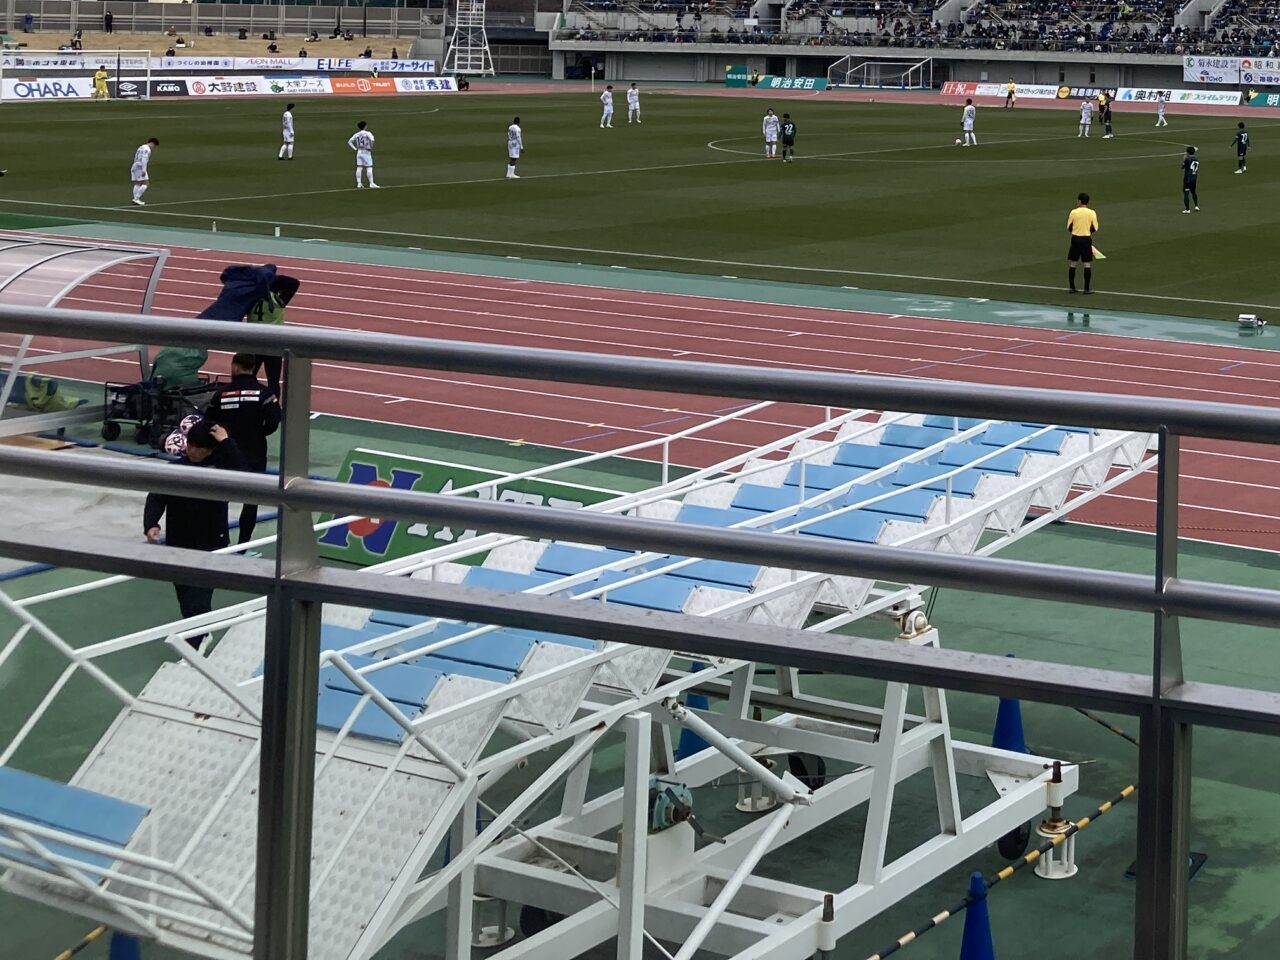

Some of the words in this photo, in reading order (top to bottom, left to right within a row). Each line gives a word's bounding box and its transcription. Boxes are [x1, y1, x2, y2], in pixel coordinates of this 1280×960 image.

[269, 58, 293, 66] MALL
[390, 60, 434, 72] フォーサイト
[156, 85, 181, 93] KAMO
[207, 81, 259, 93] 大野建設
[286, 79, 323, 88] 大栄フーズ
[426, 78, 452, 91] 秀建
[769, 77, 816, 89] 明治安田
[13, 81, 80, 98] OHARA
[1189, 160, 1200, 173] 47
